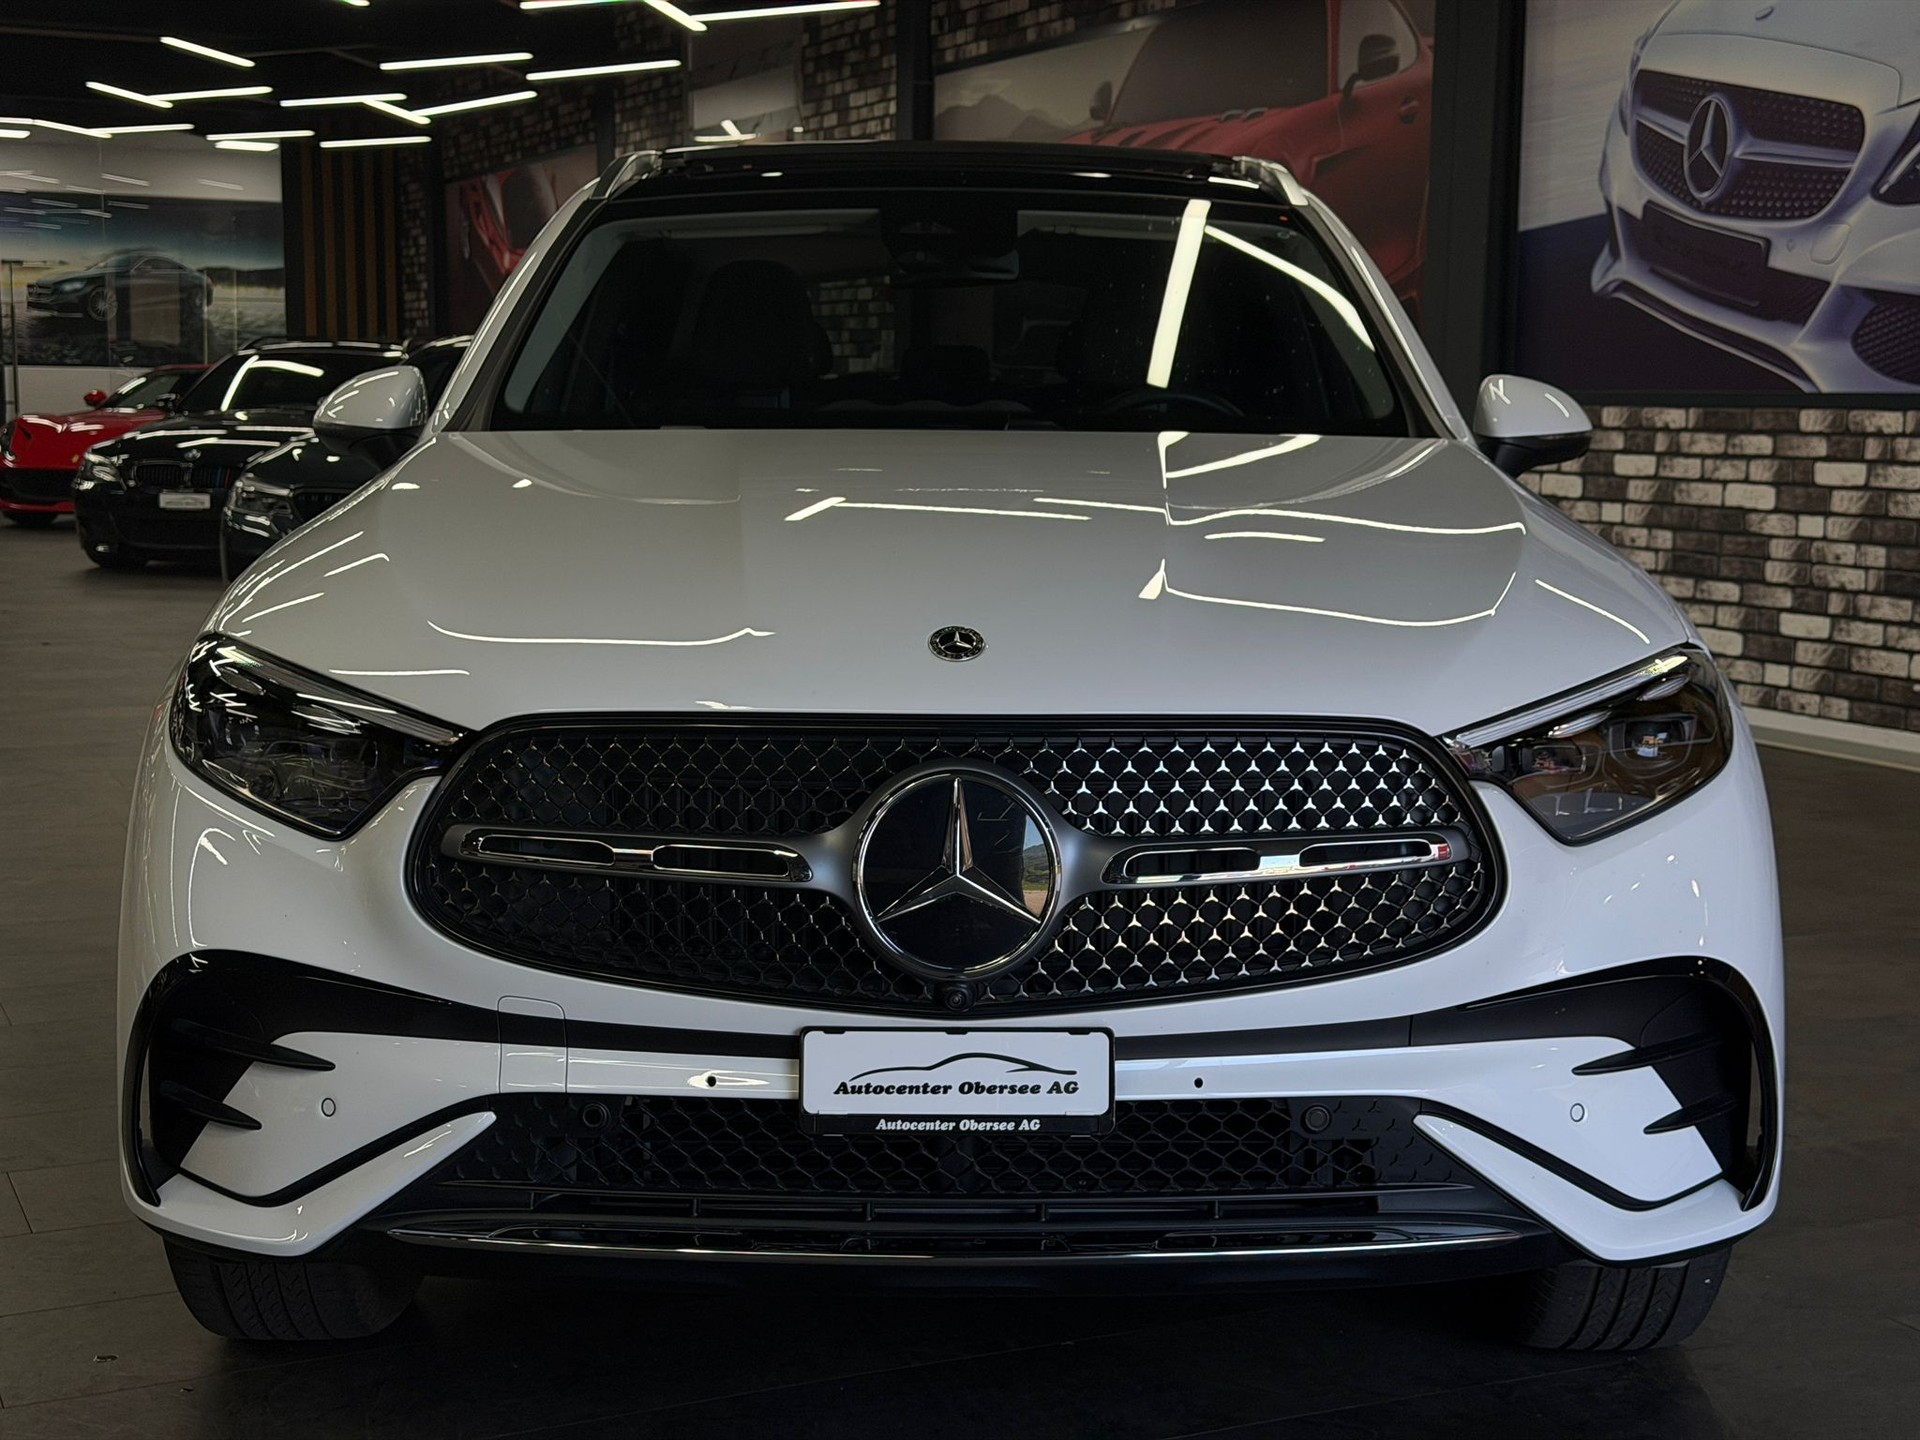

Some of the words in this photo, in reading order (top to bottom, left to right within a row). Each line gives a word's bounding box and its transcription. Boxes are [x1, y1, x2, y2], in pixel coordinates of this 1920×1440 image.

[833, 1081, 952, 1095] Autocenter
[958, 1081, 1041, 1095] Obersee
[1046, 1080, 1080, 1095] AG
[875, 1118, 956, 1131] Autocenter
[959, 1118, 1016, 1131] Obersee
[1018, 1118, 1041, 1131] AG
